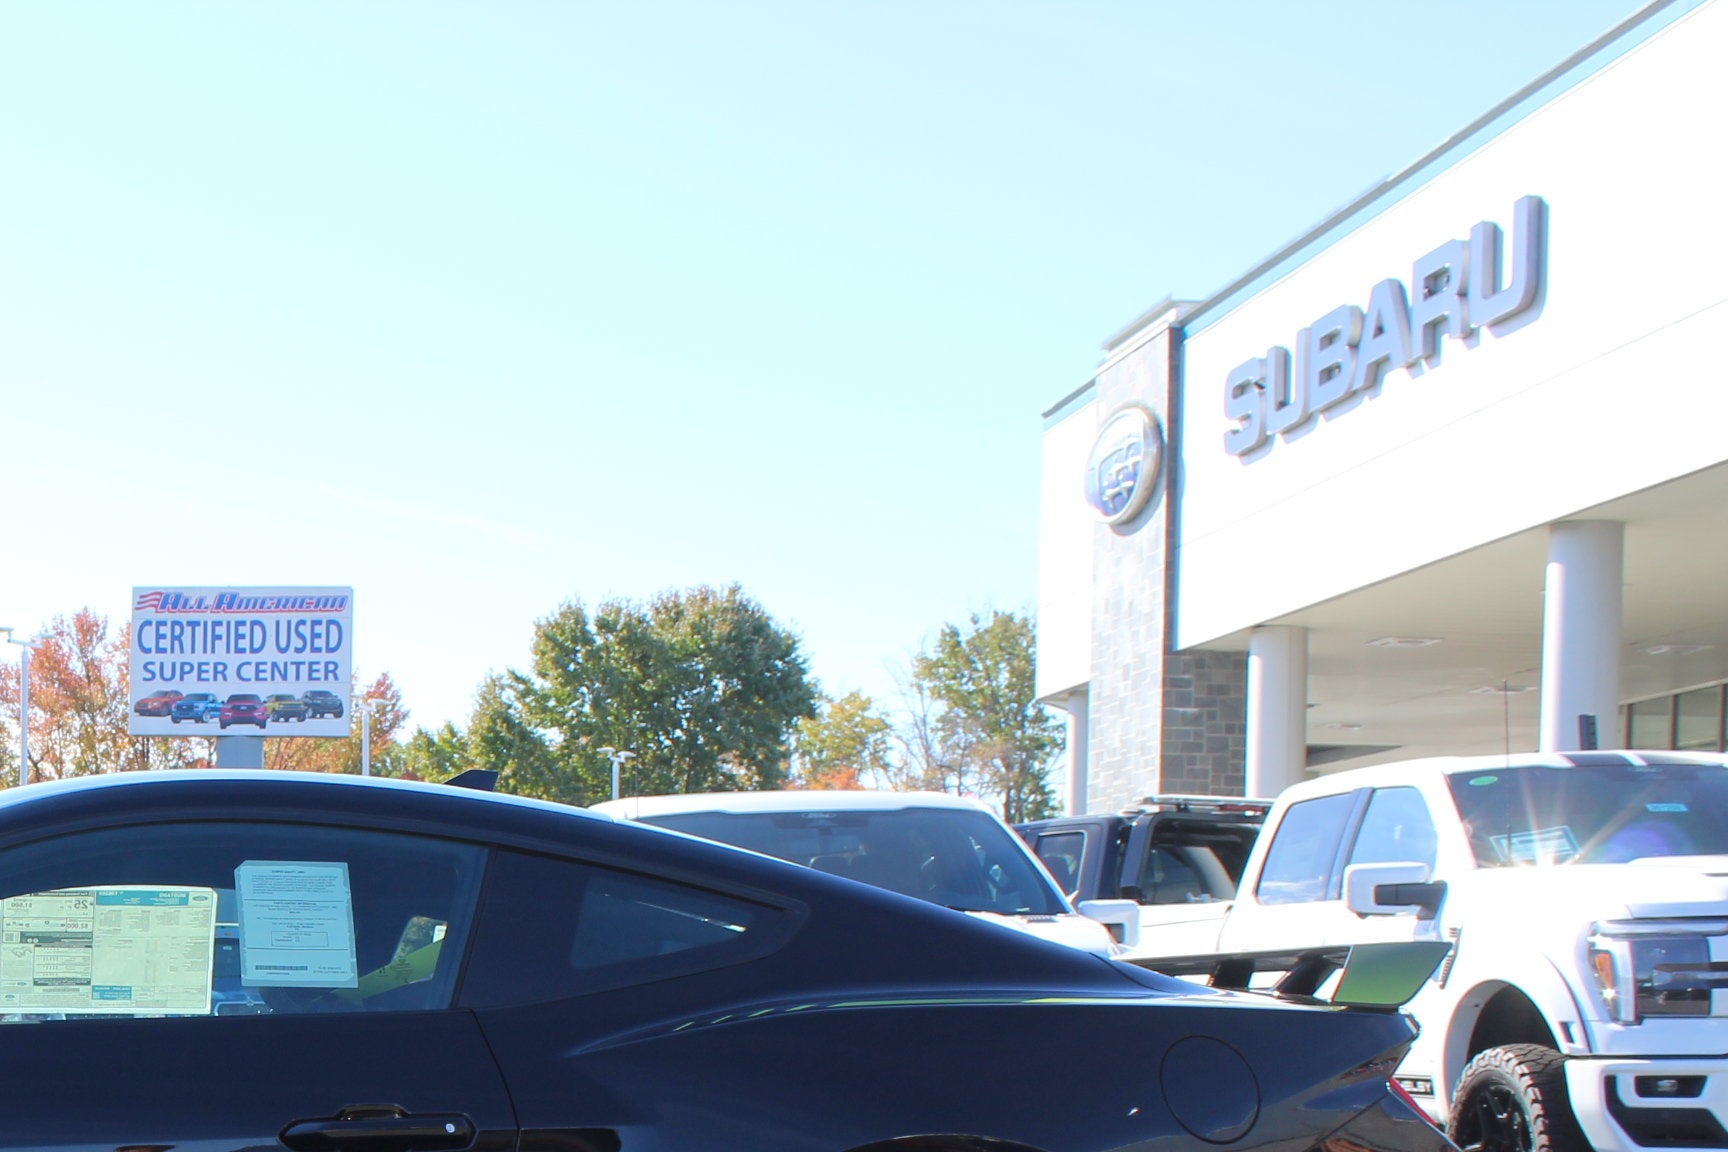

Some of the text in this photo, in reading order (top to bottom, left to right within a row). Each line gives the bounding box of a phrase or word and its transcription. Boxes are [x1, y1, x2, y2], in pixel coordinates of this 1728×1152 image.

[1224, 194, 1549, 462] SUBARU
[137, 619, 343, 654] CERTIFIED USED
[142, 661, 339, 682] SUPER CENTER
